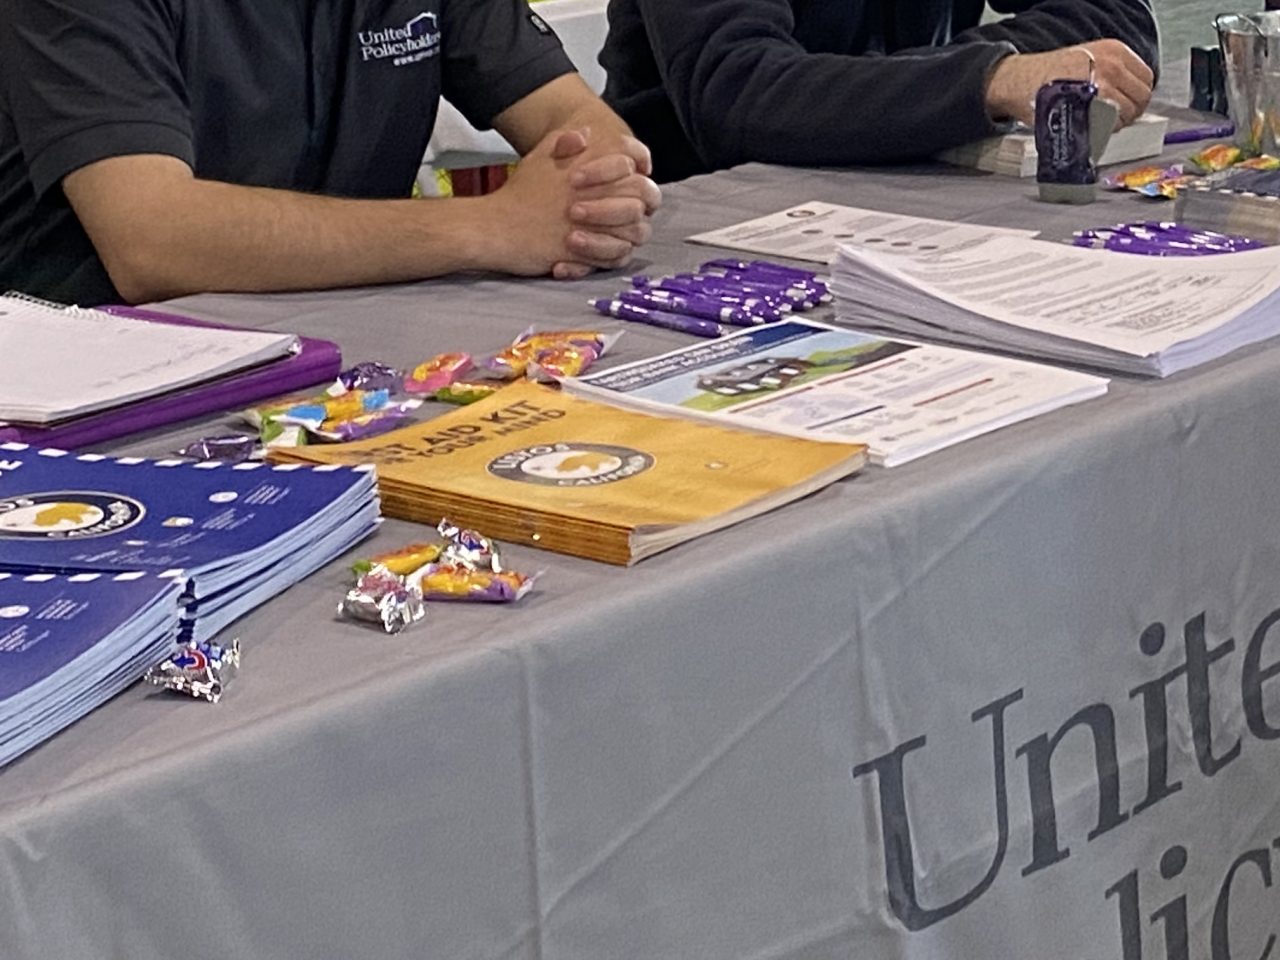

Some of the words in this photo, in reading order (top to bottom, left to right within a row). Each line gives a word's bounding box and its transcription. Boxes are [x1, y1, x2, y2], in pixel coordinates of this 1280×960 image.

[358, 24, 412, 46] United
[361, 32, 441, 61] Policyholders
[410, 435, 493, 458] YOUR
[494, 409, 567, 437] MIND
[423, 424, 482, 446] AID
[480, 400, 542, 425] KIT
